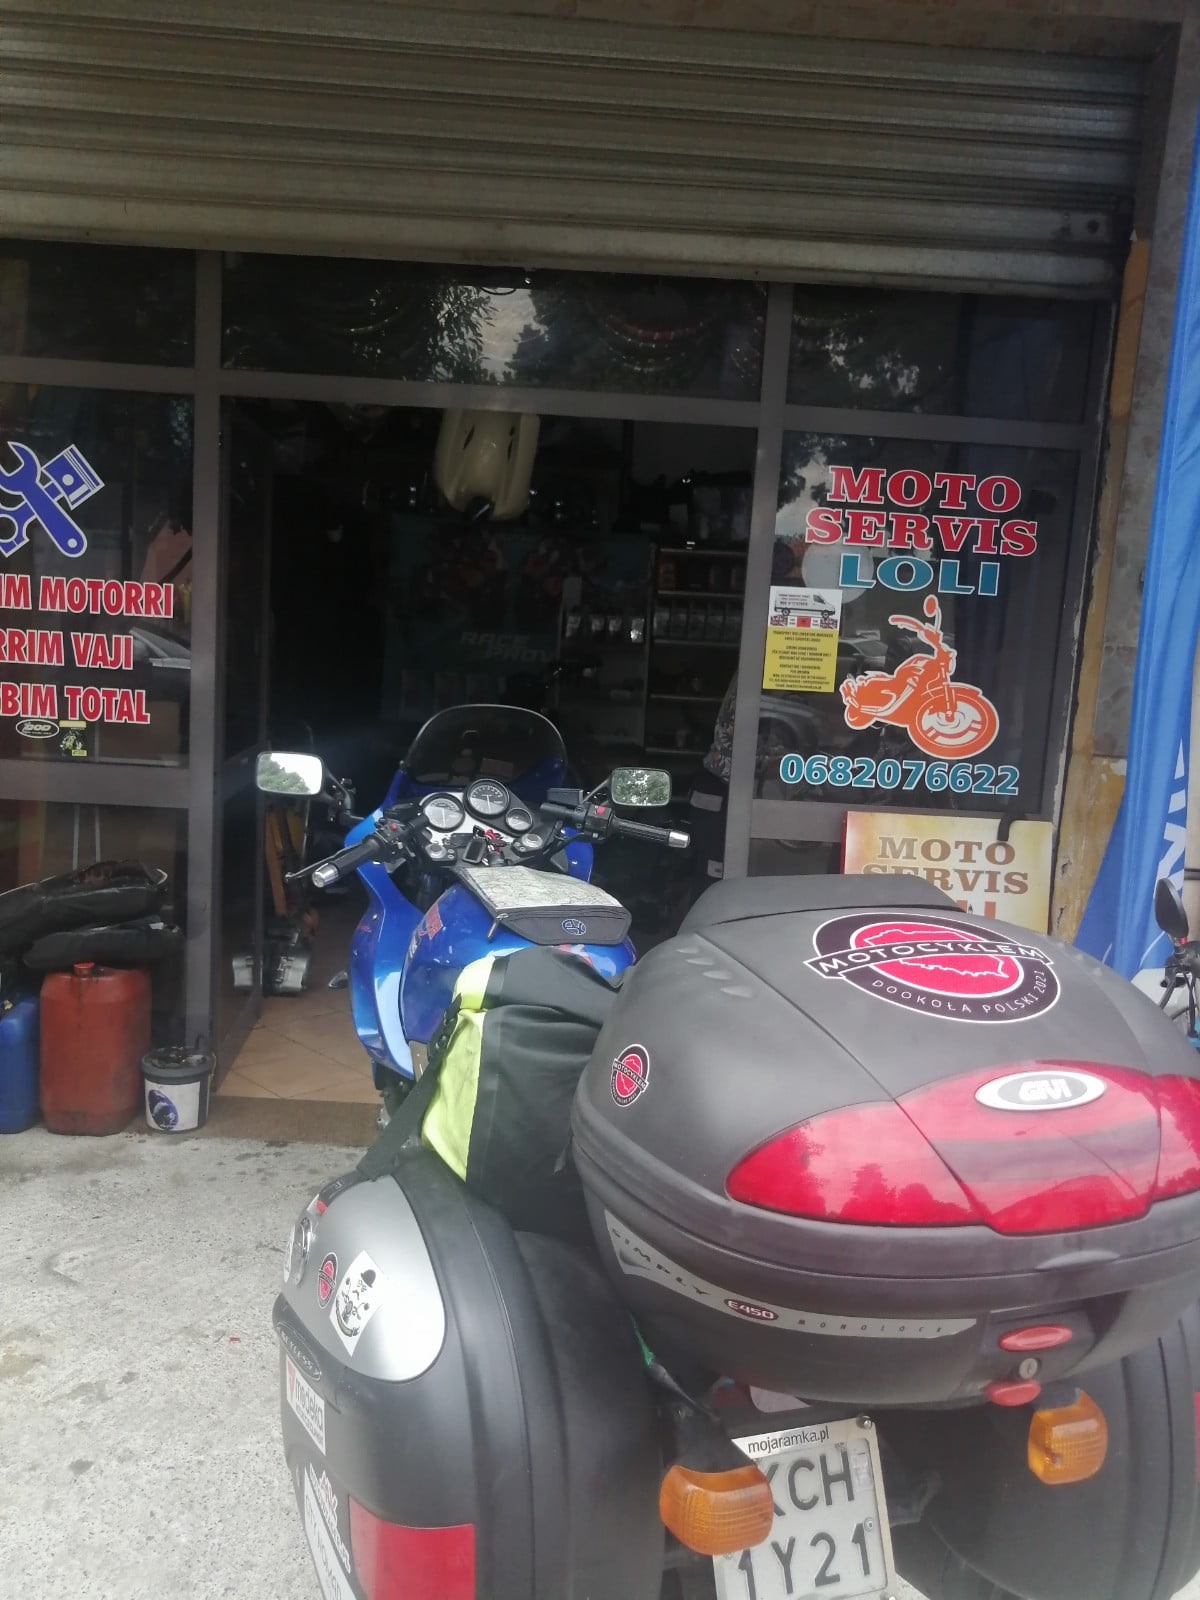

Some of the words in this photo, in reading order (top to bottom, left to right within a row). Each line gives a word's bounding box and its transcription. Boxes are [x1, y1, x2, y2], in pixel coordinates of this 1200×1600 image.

[827, 465, 1021, 513] MOTO
[805, 507, 1037, 556] SERVIS
[838, 553, 1000, 596] LOLI
[39, 576, 174, 619] MOTORRI
[71, 631, 134, 670] VAJI
[64, 686, 150, 724] TOTAL
[779, 753, 1020, 796] 0682076622
[877, 835, 1016, 866] MOTO
[862, 863, 1030, 895] RVIS
[819, 942, 1044, 974] MOTOCYKLEM
[872, 979, 972, 1014] DOOKOŁA
[982, 992, 1039, 1014] POLSKI
[727, 1300, 775, 1320] E450
[748, 1426, 830, 1455] mojaramka.pl
[738, 1522, 871, 1600] 1Y21
